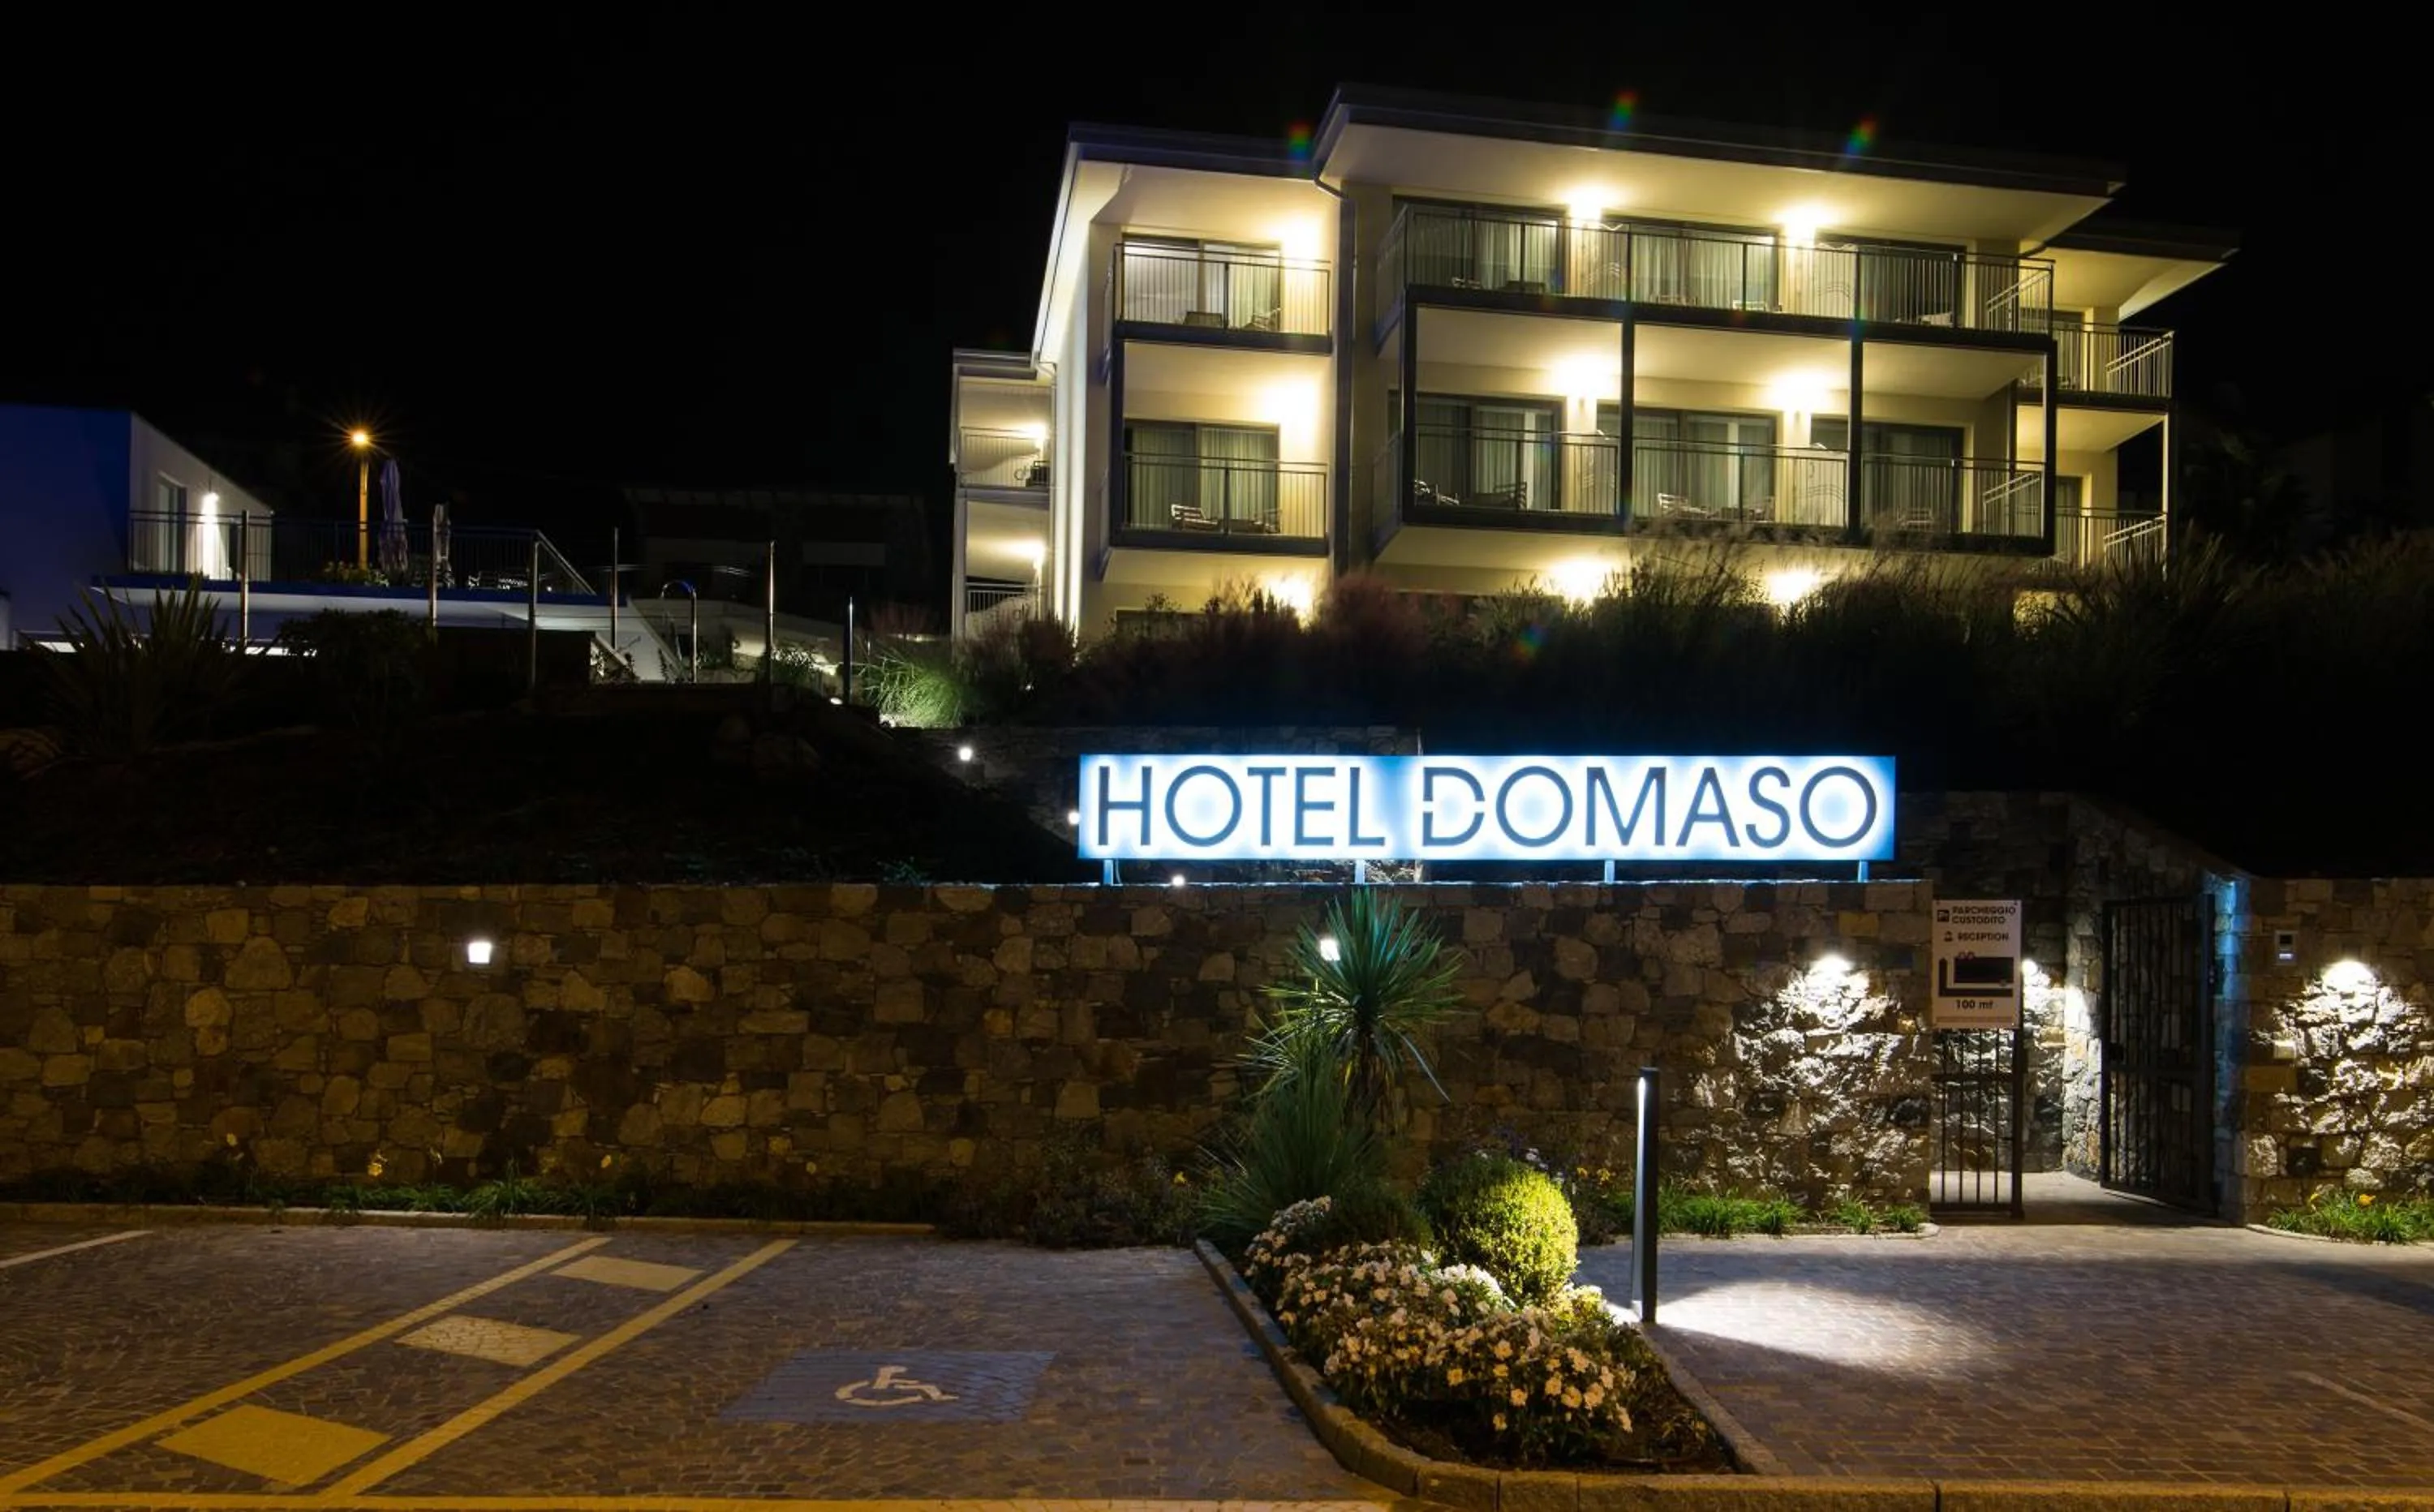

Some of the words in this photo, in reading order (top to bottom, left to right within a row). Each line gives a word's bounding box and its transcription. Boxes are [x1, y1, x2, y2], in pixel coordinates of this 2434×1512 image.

[1098, 765, 1386, 848] HOTEL
[1421, 765, 1878, 848] DOMASO
[1952, 906, 2016, 915] PARCHEGGIO
[1952, 916, 2006, 924] CUSTODITO
[1958, 932, 2010, 941] RECEPTION
[1956, 999, 1976, 1009] 100
